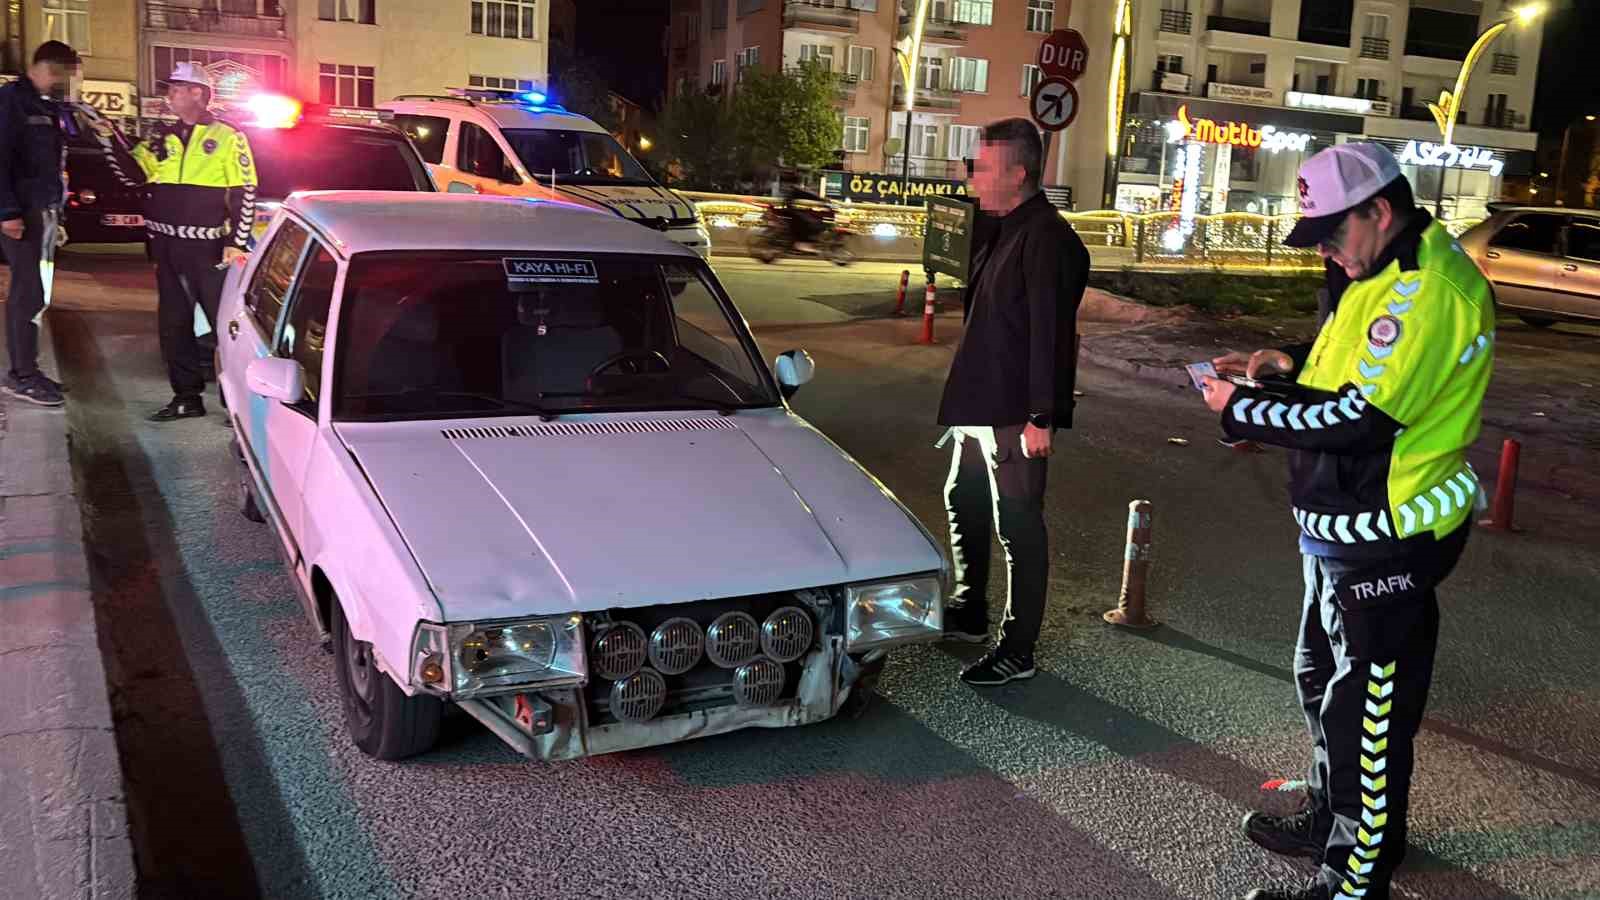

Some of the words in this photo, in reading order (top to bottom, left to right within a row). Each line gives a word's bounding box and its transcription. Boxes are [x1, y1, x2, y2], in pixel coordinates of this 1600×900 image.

[1041, 43, 1084, 71] DUR
[850, 175, 873, 193] ÖZ
[876, 180, 973, 198] ÇAKMAKLA
[513, 262, 553, 273] KAYA
[555, 263, 588, 274] HI-FI
[1349, 572, 1416, 600] TRAFIK
